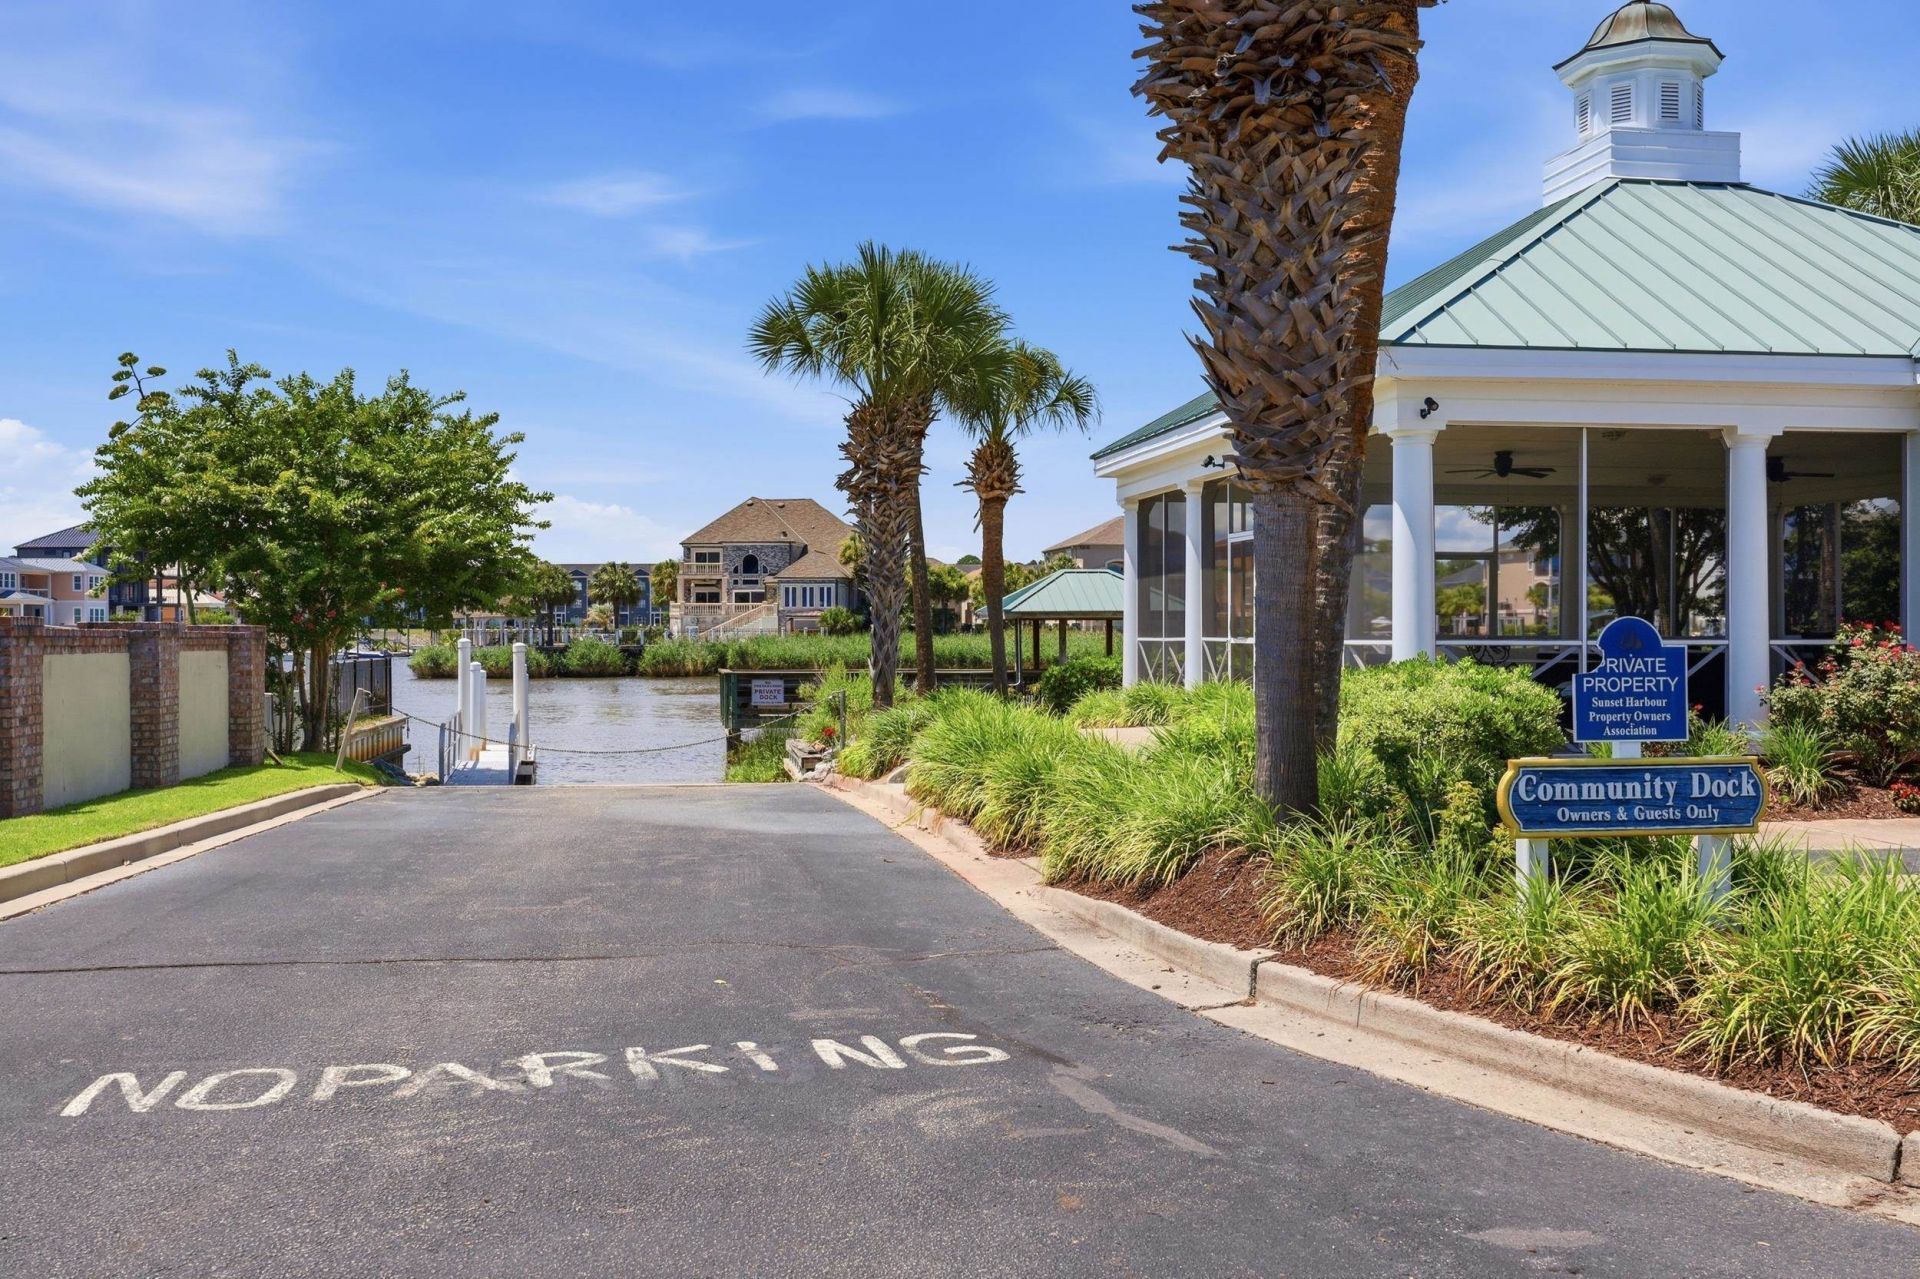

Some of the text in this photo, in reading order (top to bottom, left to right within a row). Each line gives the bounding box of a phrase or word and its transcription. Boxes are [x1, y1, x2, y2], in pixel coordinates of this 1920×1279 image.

[1583, 677, 1679, 692] PROPERTY
[1592, 697, 1667, 707] Sunset Harbour
[1589, 711, 1671, 723] Property Owners
[1603, 725, 1657, 736] Association
[1518, 771, 1756, 806] Community Dock
[1557, 804, 1720, 822] Owners & Guests Only
[59, 1032, 1011, 1116] NO PARKING
